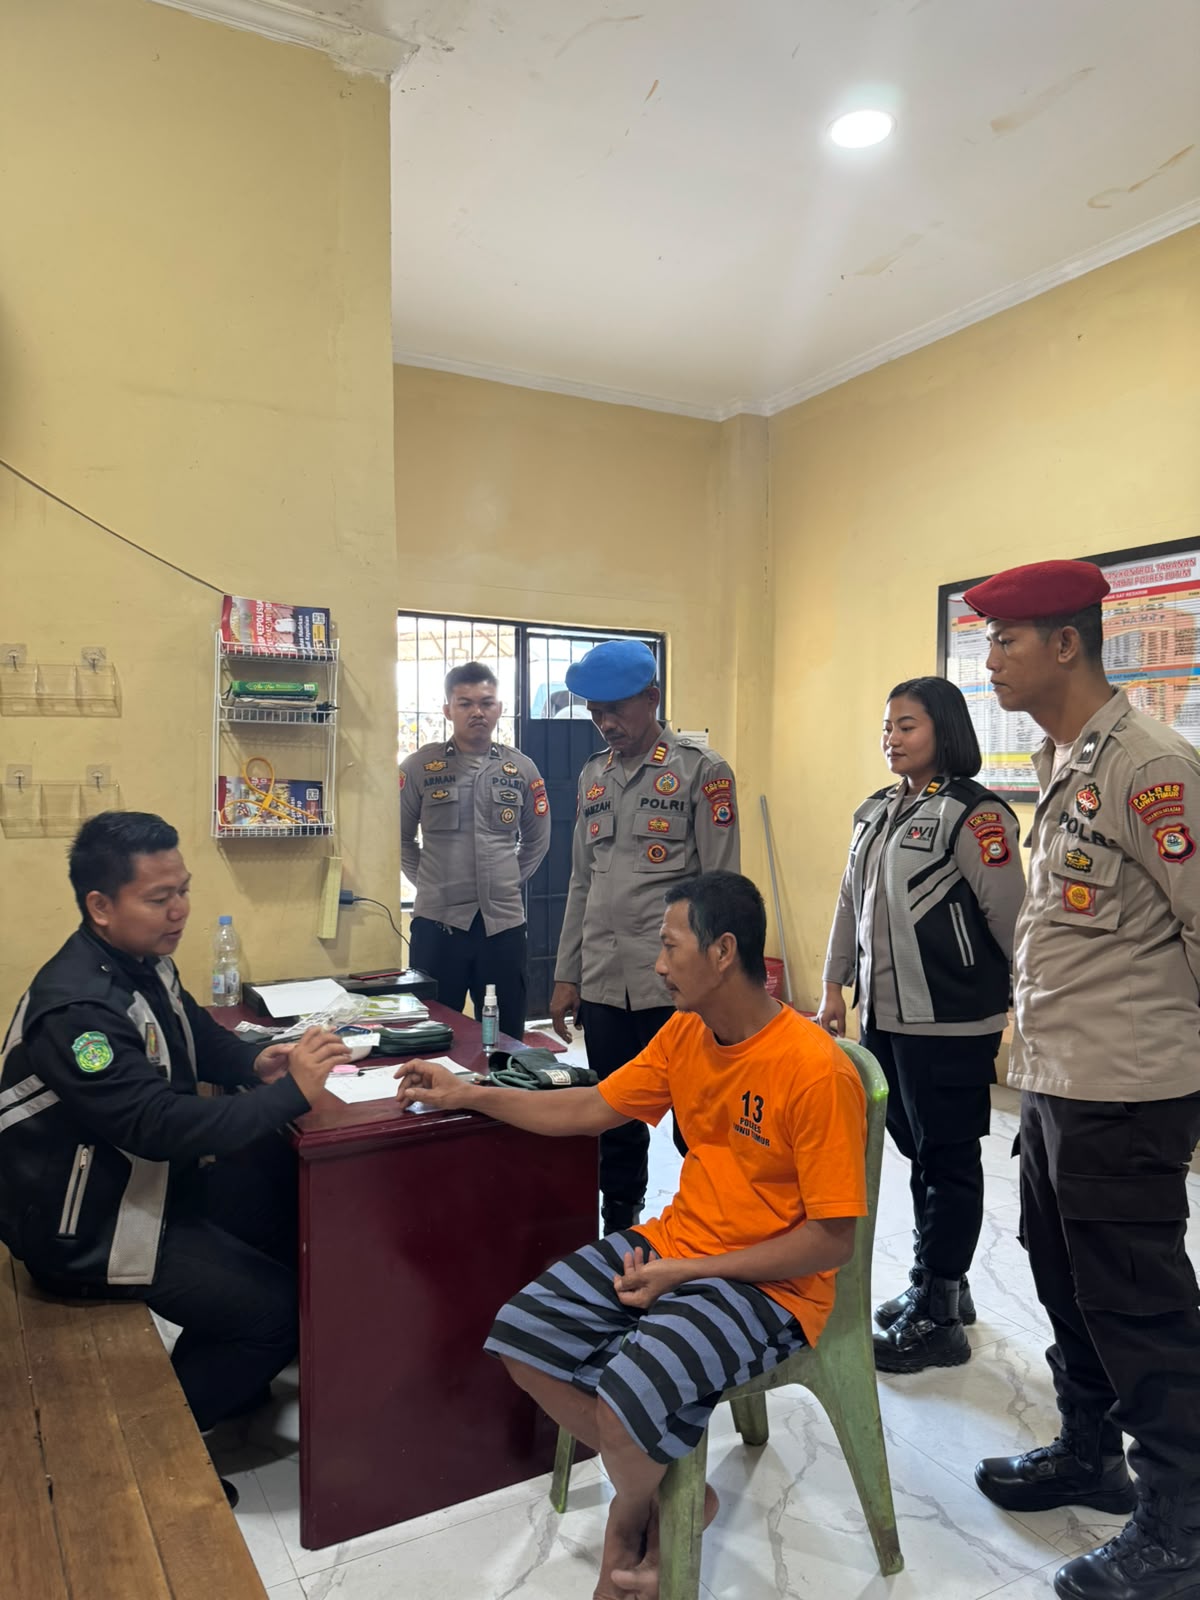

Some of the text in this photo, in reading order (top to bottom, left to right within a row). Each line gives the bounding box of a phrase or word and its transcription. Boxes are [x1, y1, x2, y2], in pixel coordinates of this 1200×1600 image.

[1156, 557, 1197, 571] TAHANAN
[1134, 573, 1164, 586] POLRES
[424, 775, 456, 787] ARMAN
[1133, 785, 1180, 807] POLRES
[640, 797, 683, 812] POLRI
[1060, 811, 1110, 847] POLR
[741, 1090, 764, 1124] 13
[739, 1117, 762, 1134] POLRES
